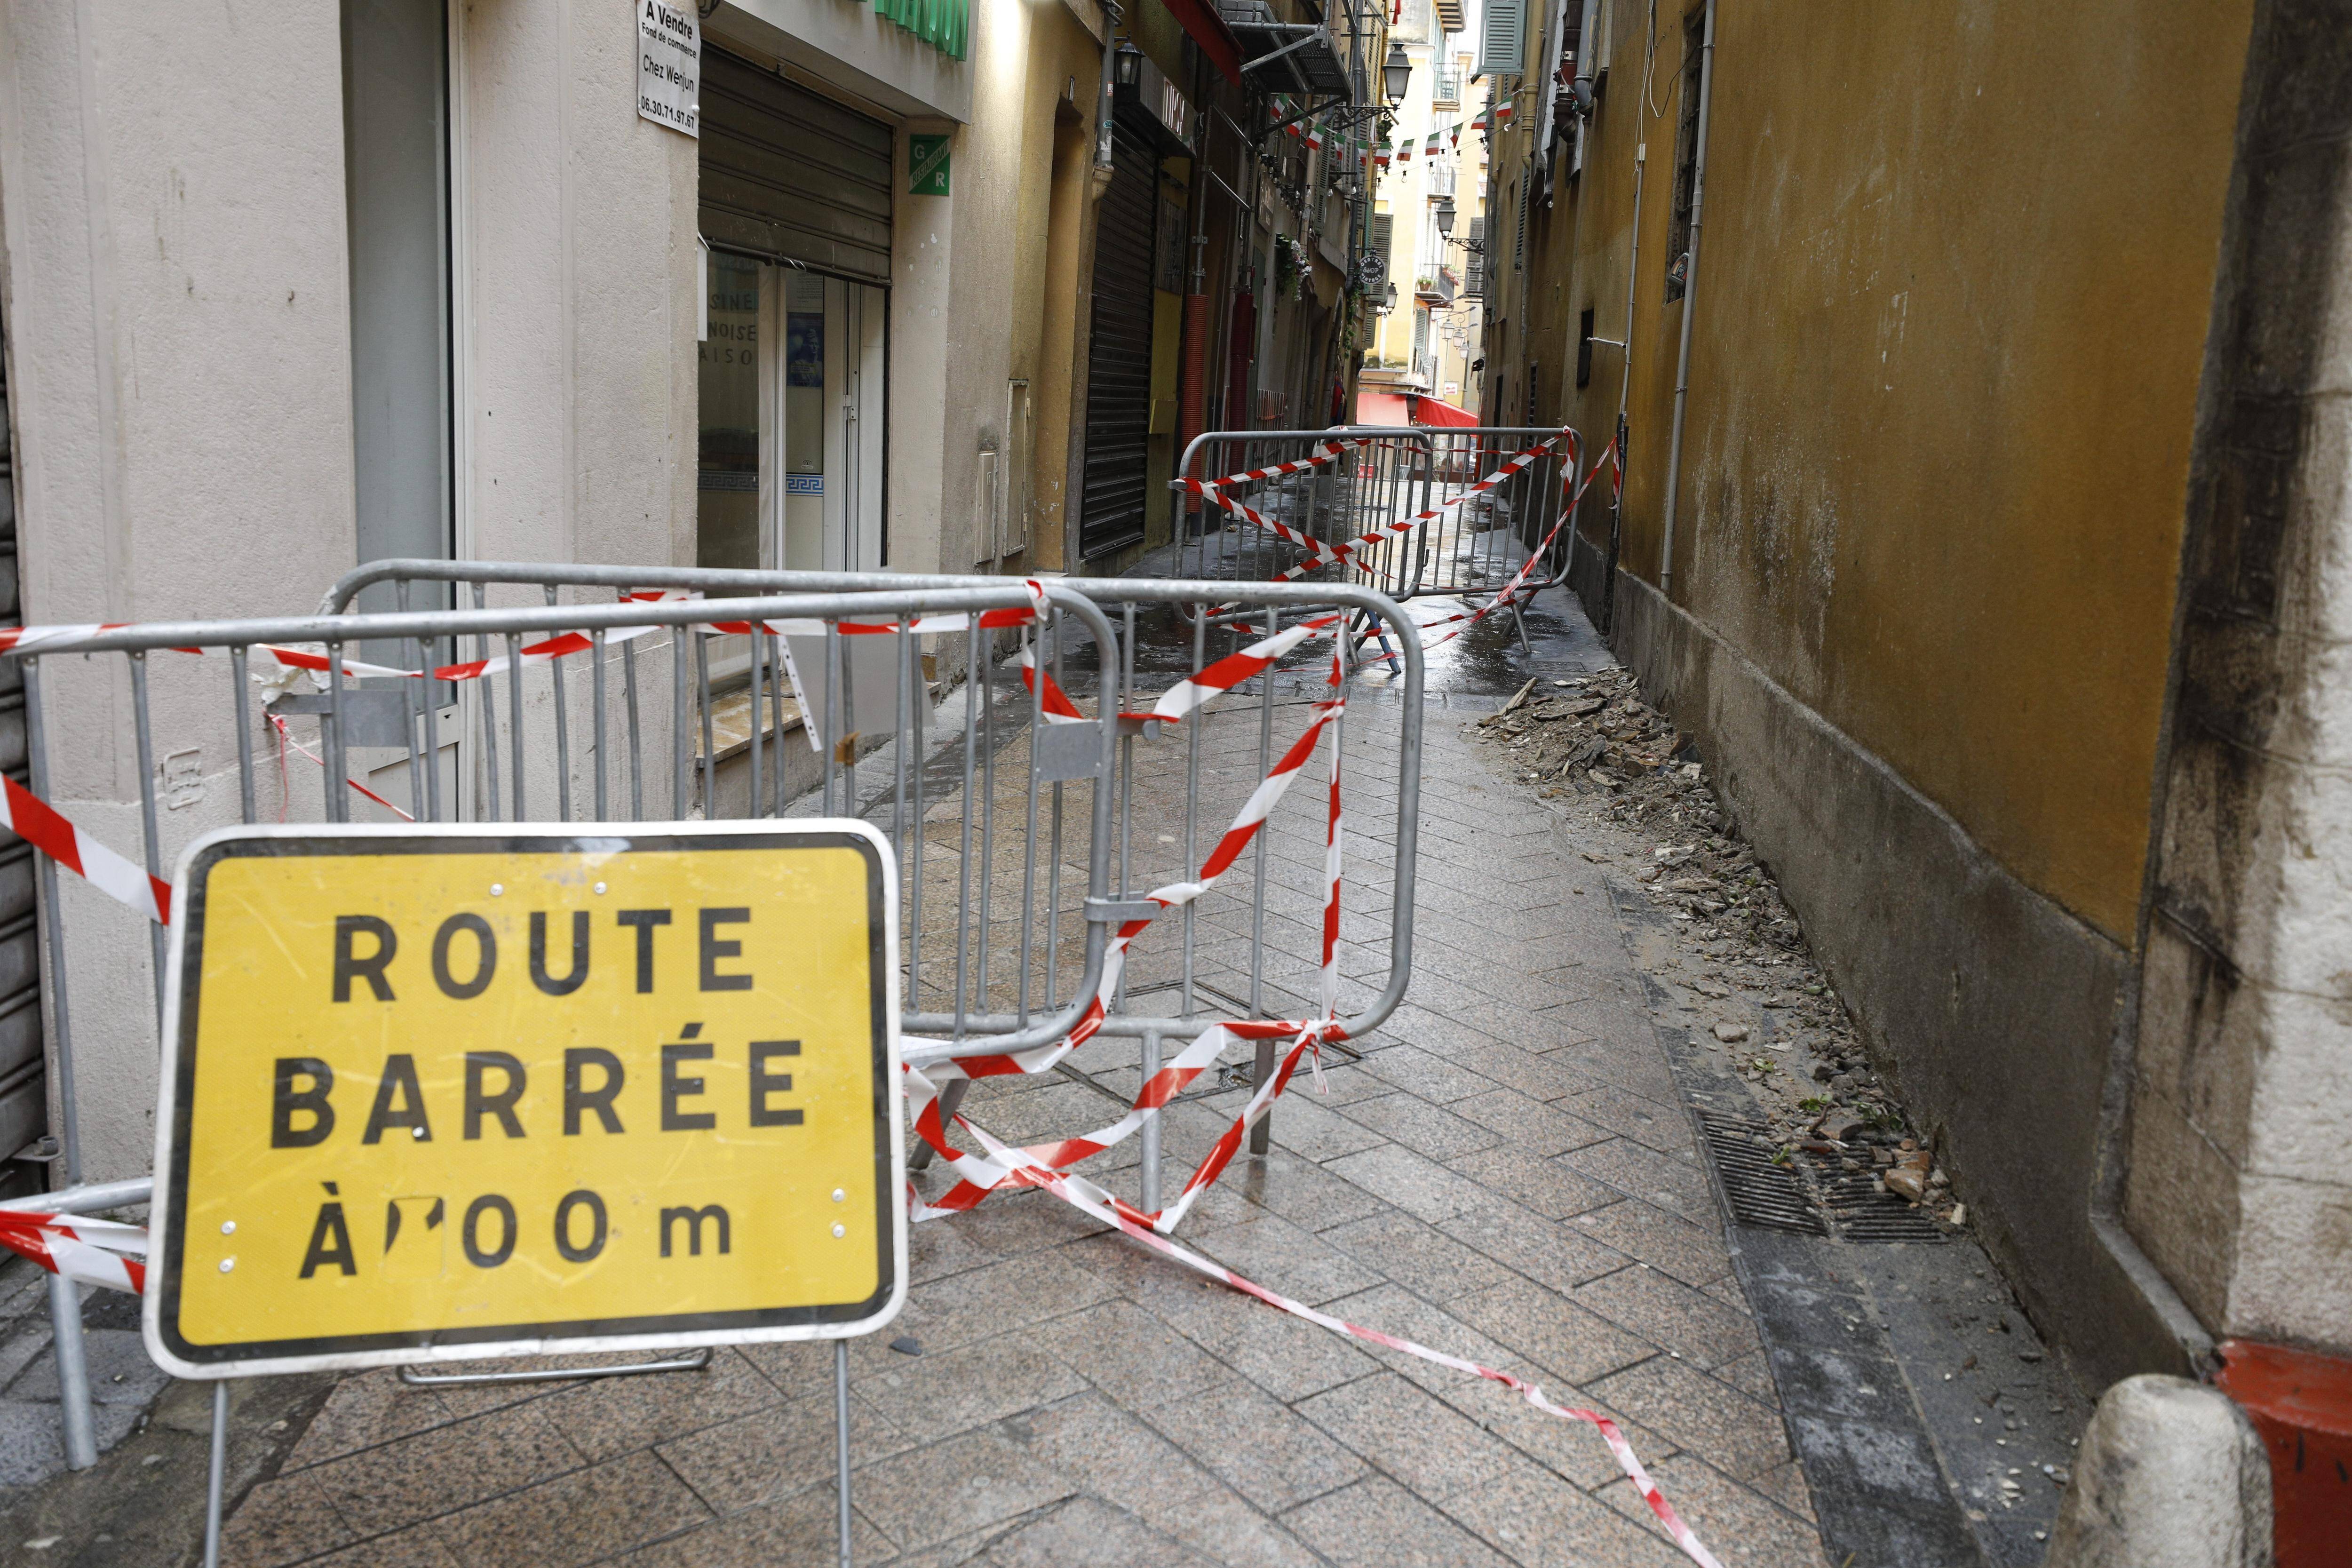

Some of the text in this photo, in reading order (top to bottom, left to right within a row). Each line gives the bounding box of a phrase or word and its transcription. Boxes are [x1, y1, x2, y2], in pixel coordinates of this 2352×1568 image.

[642, 22, 696, 58] Fond de commerce
[658, 4, 692, 40] Vendre
[643, 54, 694, 92] Chez Wenjun
[641, 96, 694, 129] 06.30.71.97.67
[913, 140, 947, 187] RESTAURANT
[914, 144, 925, 159] G
[935, 171, 945, 187] R
[333, 907, 753, 1003] ROUTE
[271, 1023, 803, 1149] BARRÉE
[298, 1181, 357, 1279] À
[660, 1203, 731, 1257] m
